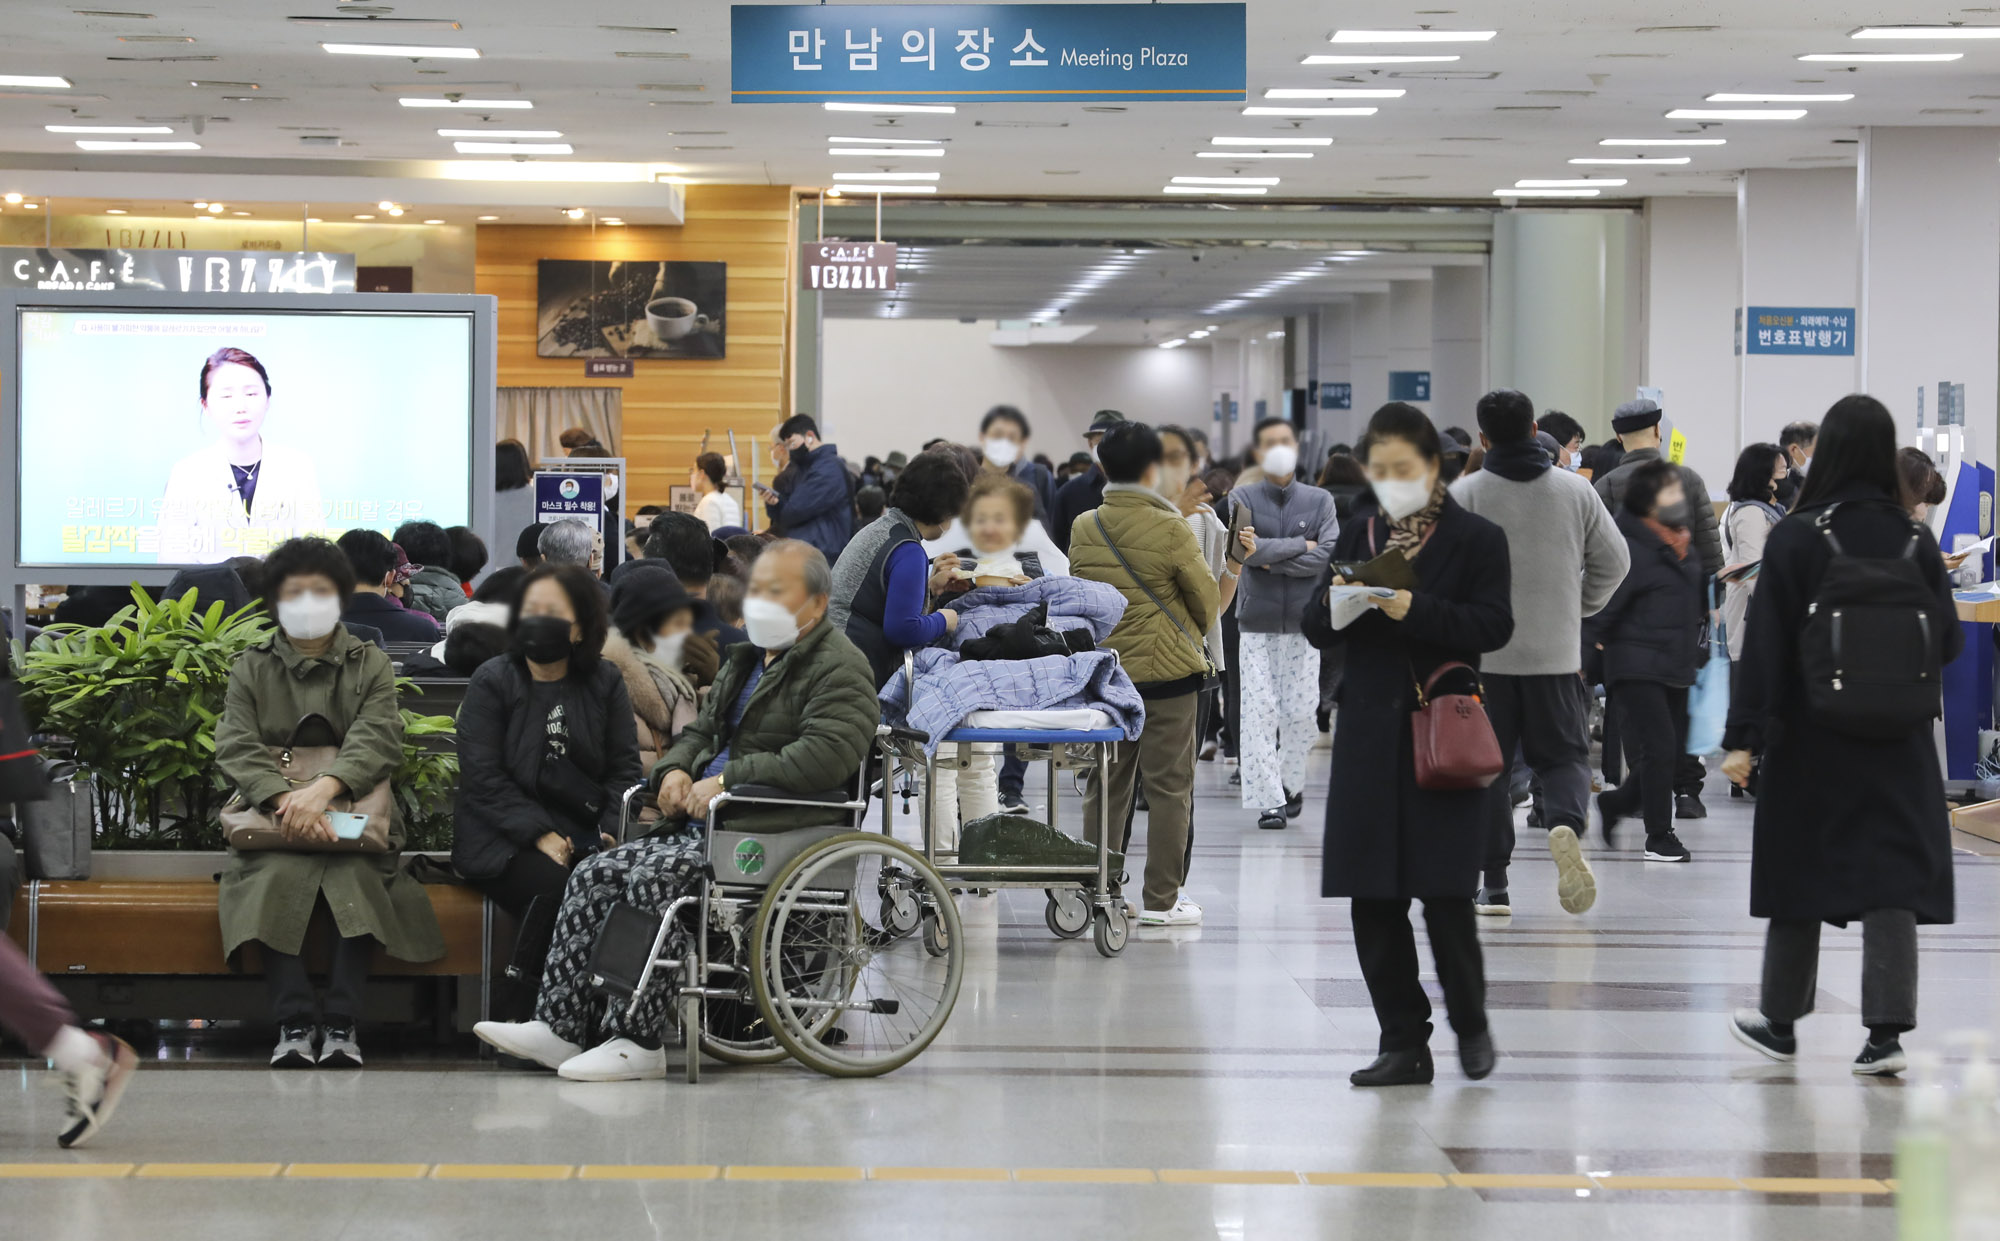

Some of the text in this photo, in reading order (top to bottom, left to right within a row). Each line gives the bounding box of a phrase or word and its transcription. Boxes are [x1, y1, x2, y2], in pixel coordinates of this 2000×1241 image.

[1060, 47, 1189, 70] Meeting Plaza
[1758, 329, 1847, 347] 번호표발행기
[65, 497, 145, 520] 알레르기
[385, 499, 424, 521] 경우
[541, 501, 596, 512] 마스크 필수 착용!
[62, 525, 161, 553] 탈감작을
